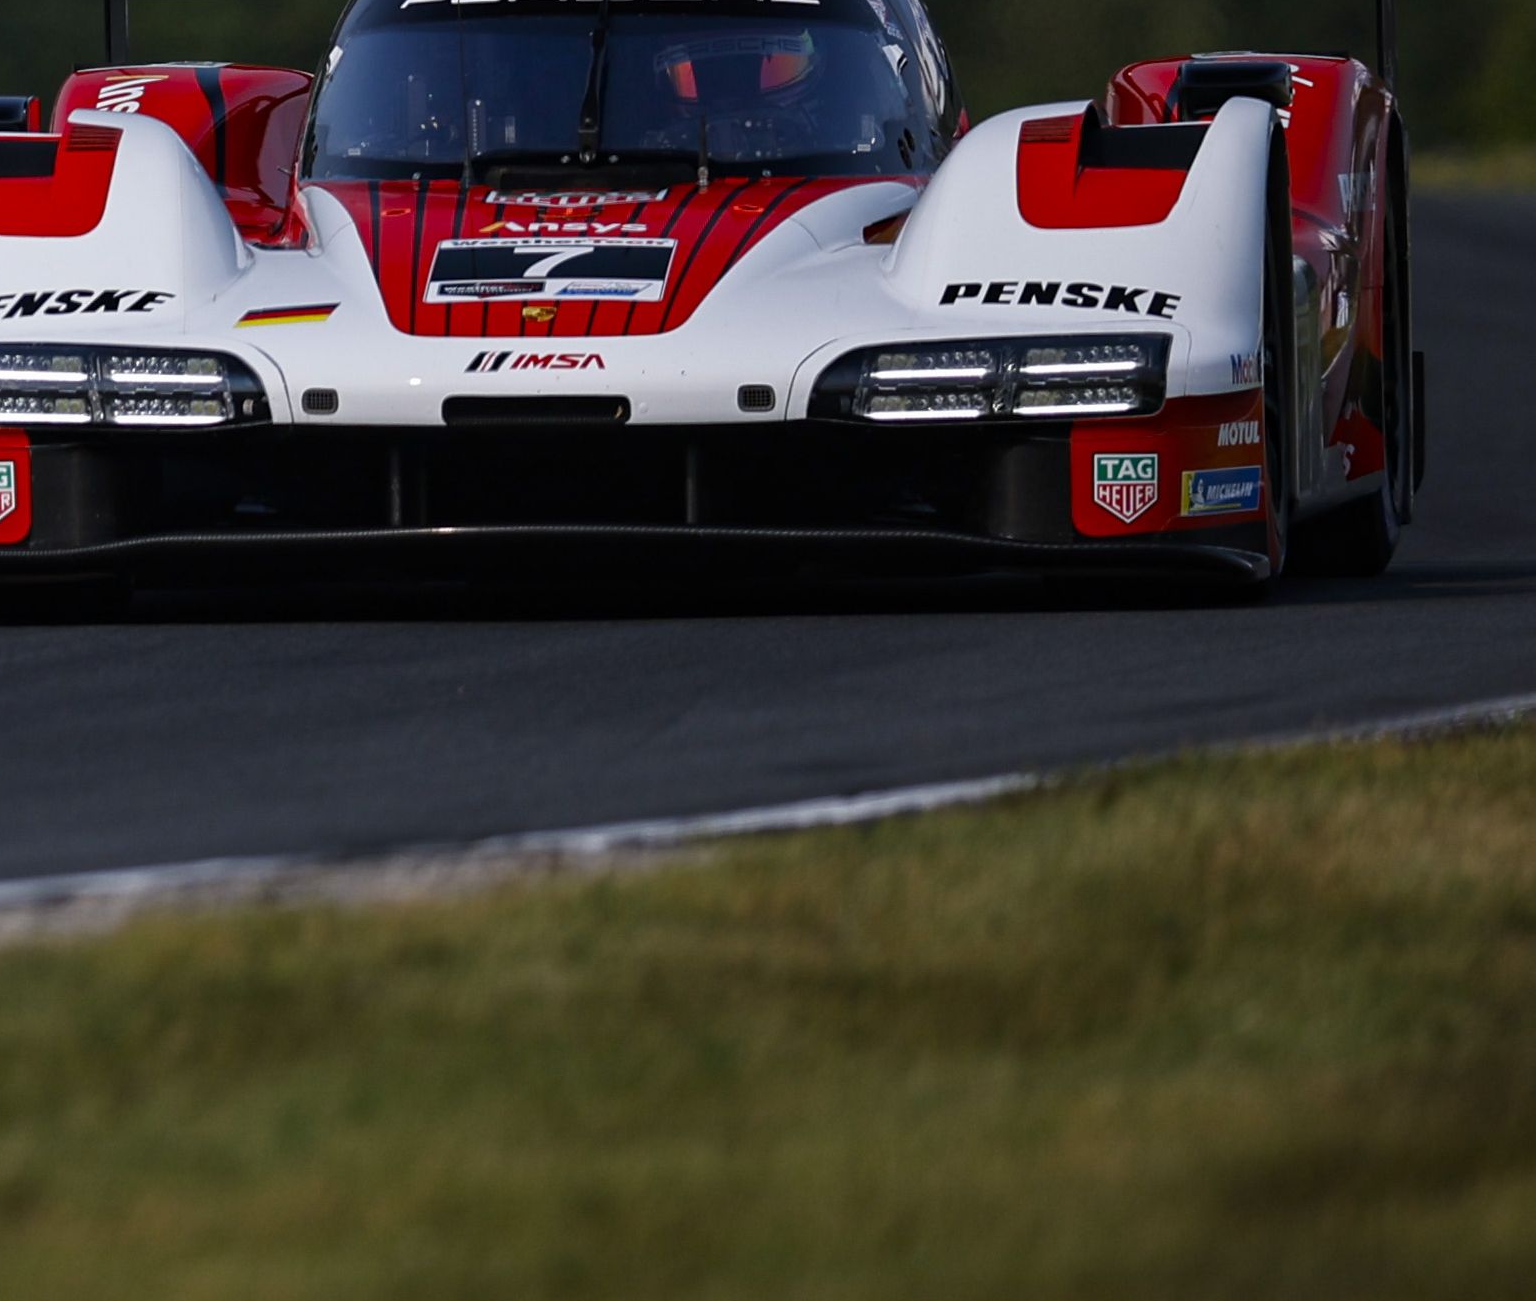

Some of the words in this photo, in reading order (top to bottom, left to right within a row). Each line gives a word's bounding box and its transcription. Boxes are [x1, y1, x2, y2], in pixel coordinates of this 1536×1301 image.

[479, 220, 648, 234] Ansys
[513, 246, 596, 278] 7
[939, 280, 1182, 320] PENSKE
[509, 353, 606, 370] IMSA
[1216, 420, 1261, 447] MOTUL
[1100, 459, 1153, 480] TAG
[1098, 485, 1154, 518] HEUER
[1206, 481, 1255, 500] MICHELIN
